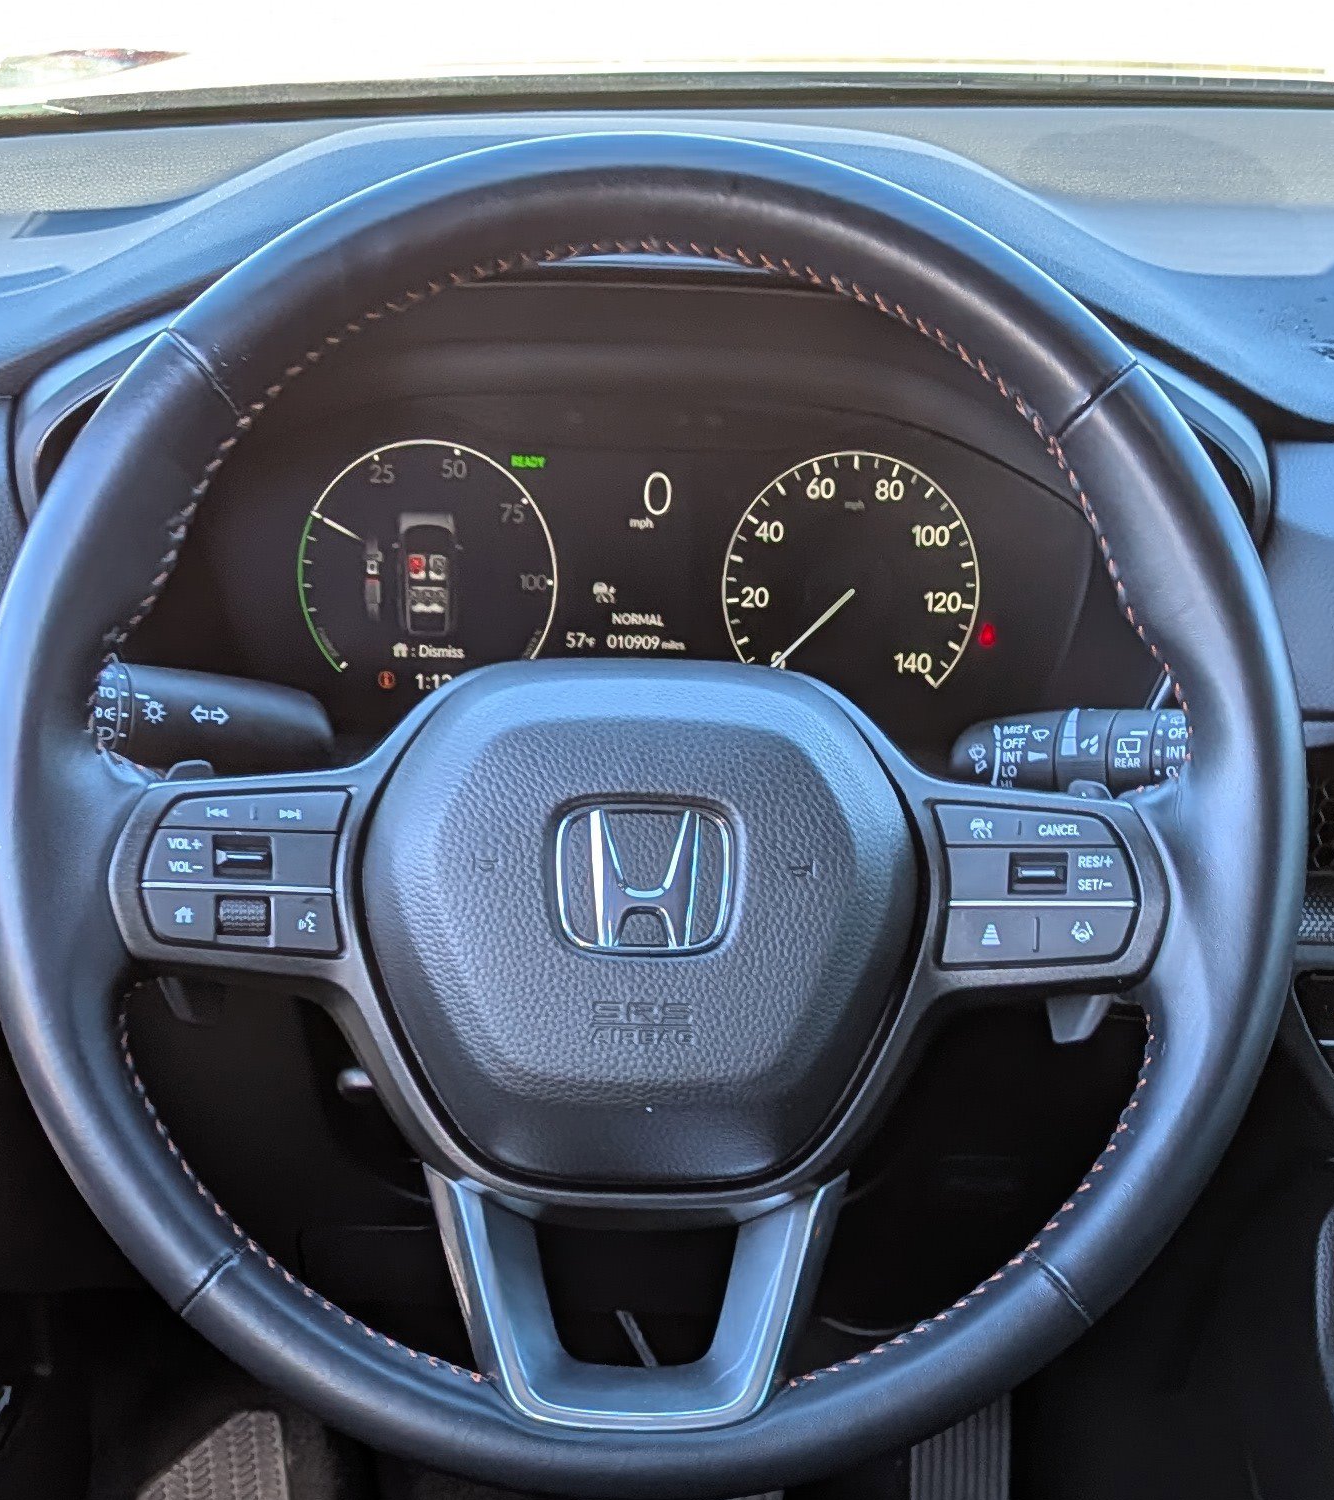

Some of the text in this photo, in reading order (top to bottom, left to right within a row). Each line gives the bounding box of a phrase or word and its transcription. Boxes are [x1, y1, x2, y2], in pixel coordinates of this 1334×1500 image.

[369, 465, 396, 484] 25
[442, 459, 467, 479] 50
[644, 471, 672, 516] 0
[806, 478, 836, 500] 60
[874, 479, 905, 501] 80
[500, 503, 525, 524] 75
[629, 517, 655, 530] mph
[754, 521, 785, 543] 40
[911, 525, 950, 547] 100
[520, 574, 547, 591] 100
[741, 587, 769, 608] 20
[924, 591, 962, 613] 120
[611, 612, 665, 628] NORMAL
[606, 634, 661, 650] 010909
[418, 645, 465, 658] Dismiss
[894, 652, 932, 674] 140
[1003, 725, 1031, 735] MIST
[1003, 738, 1026, 749] OFF
[1002, 752, 1022, 763] INT
[1114, 757, 1141, 769] REAR
[1001, 766, 1017, 778] LO
[1038, 824, 1080, 837] CANCEL
[167, 837, 203, 850] VOL+
[1078, 855, 1114, 868] RES/+
[591, 1001, 693, 1024] SRS
[591, 1029, 695, 1046] AIRBAG
